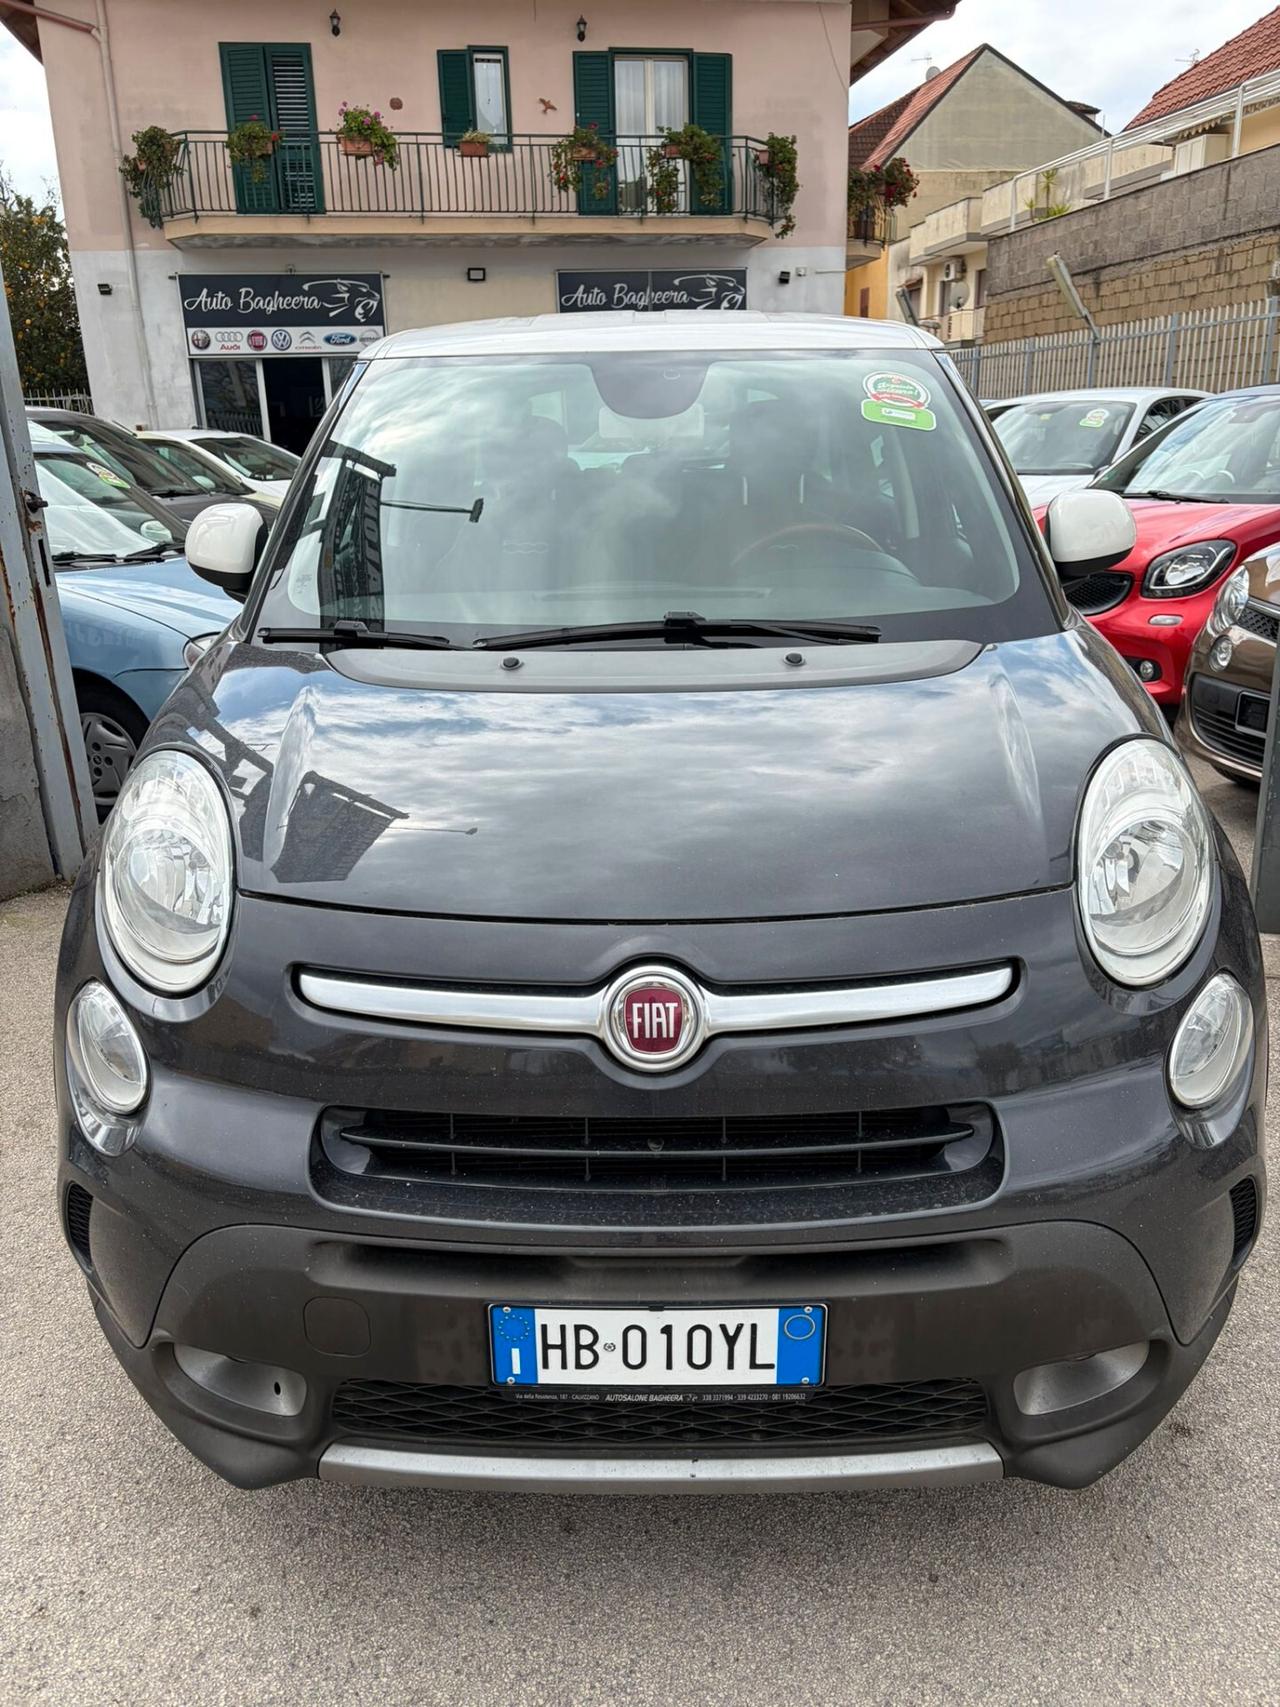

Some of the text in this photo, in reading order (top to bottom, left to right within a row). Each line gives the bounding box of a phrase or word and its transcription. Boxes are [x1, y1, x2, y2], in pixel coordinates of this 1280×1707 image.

[184, 287, 322, 315] Auto Bagheera
[561, 284, 607, 306] Auto
[632, 1002, 678, 1039] FIAT
[540, 1323, 776, 1371] HB 010YL
[605, 1393, 684, 1402] AUTOSALONE BAGHEERA
